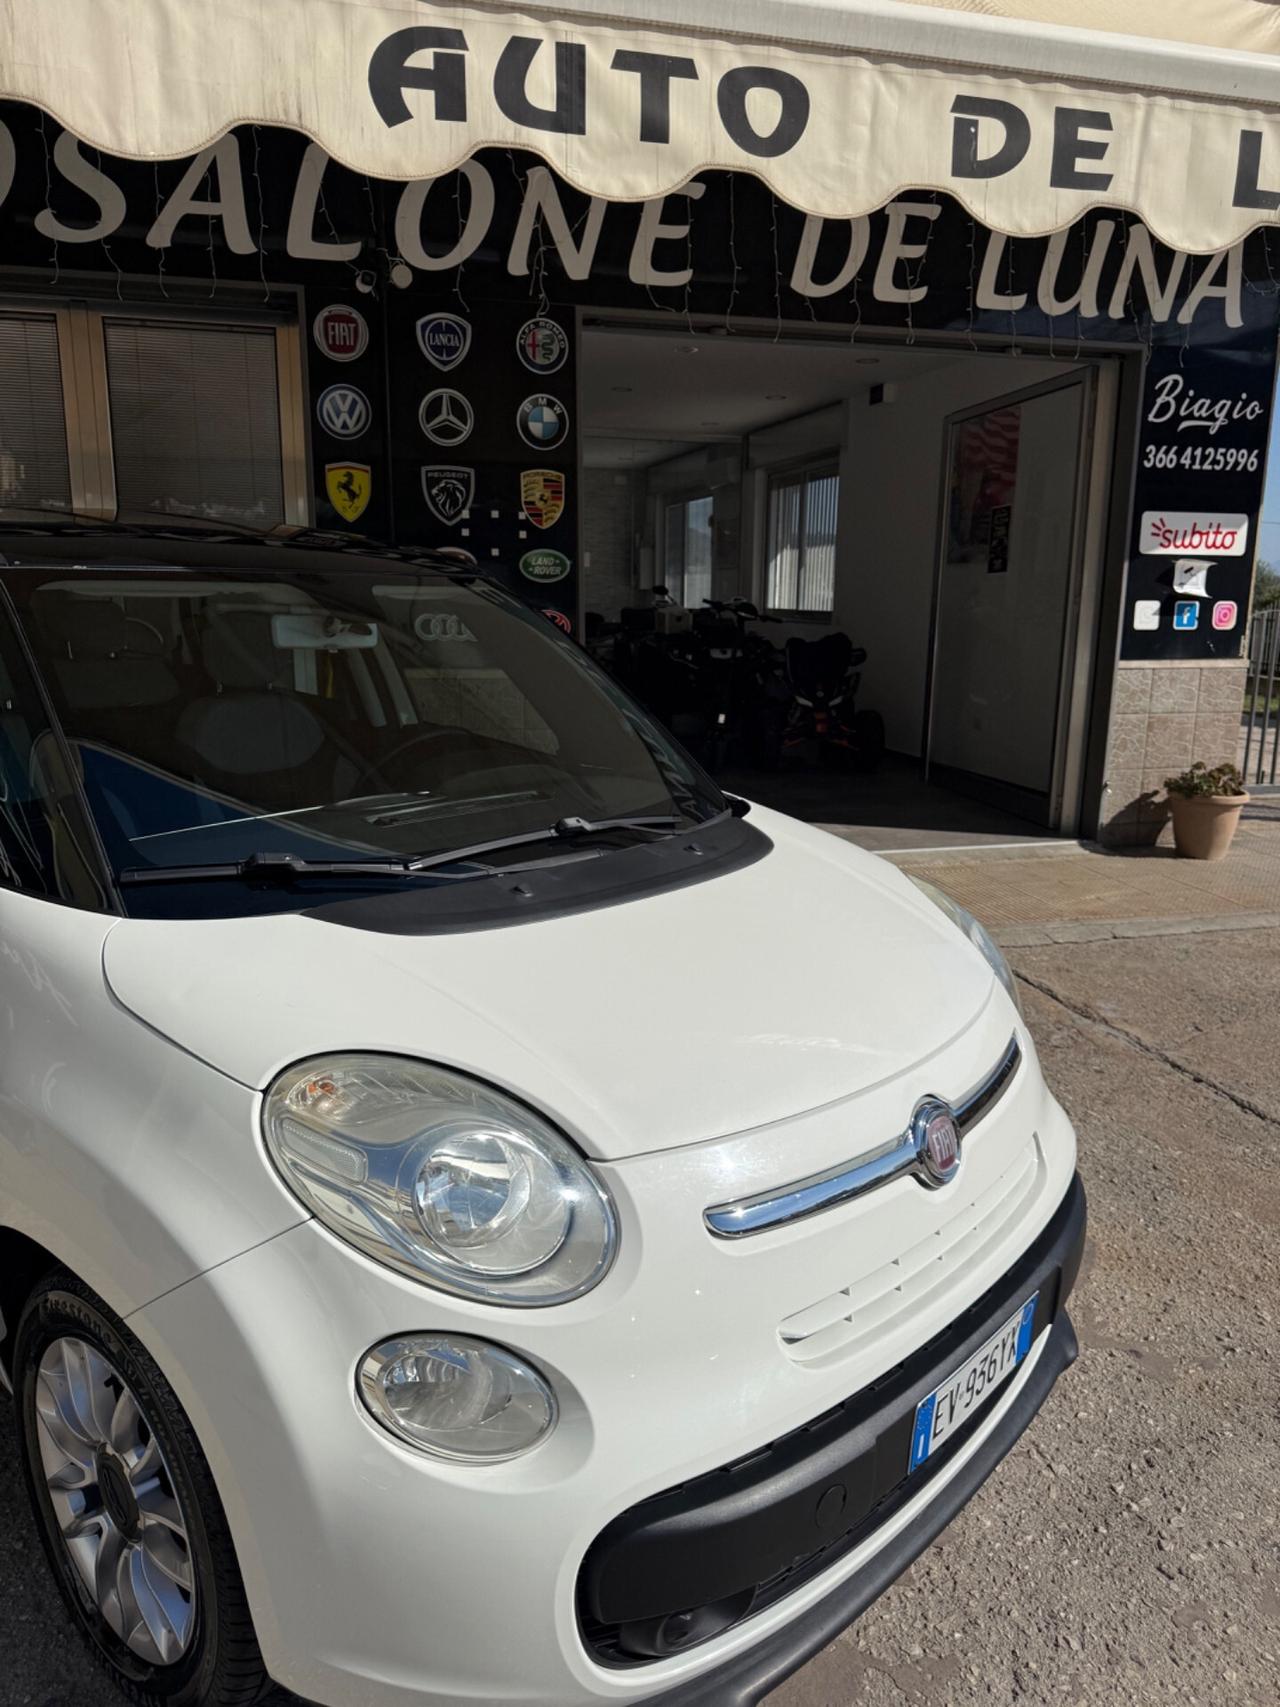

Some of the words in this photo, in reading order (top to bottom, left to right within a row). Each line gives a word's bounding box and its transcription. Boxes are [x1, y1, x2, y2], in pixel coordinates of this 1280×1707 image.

[368, 25, 811, 158] AUTO
[950, 94, 1114, 192] DE
[1231, 128, 1280, 210] L
[790, 202, 942, 303] DE
[975, 219, 1245, 328] LUNA
[327, 322, 358, 347] FIAT
[429, 332, 460, 347] LANCIA
[519, 323, 536, 345] ALFA
[539, 320, 566, 349] ROMEO
[523, 397, 563, 416] BMW
[1147, 374, 1264, 435] Biagio
[1143, 445, 1178, 469] 366
[1179, 446, 1260, 472] 4125996
[1159, 520, 1238, 550] subito
[531, 557, 555, 567] LAND
[532, 566, 562, 575] ROVER
